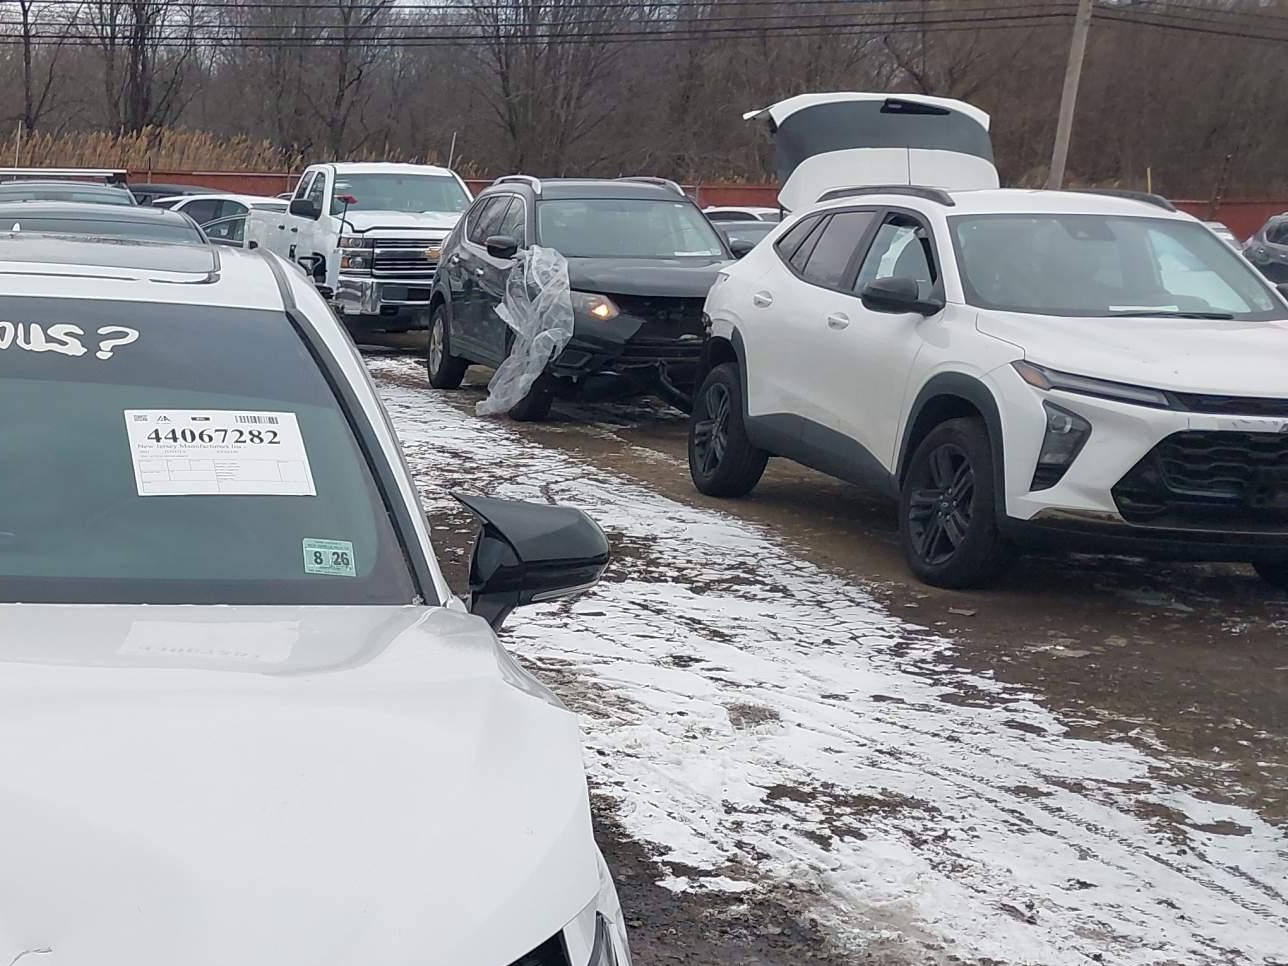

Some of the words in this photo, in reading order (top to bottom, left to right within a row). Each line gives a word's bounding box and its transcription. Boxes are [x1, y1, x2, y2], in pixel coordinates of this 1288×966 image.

[147, 428, 281, 445] 44067282
[314, 551, 323, 565] 8
[332, 551, 350, 566] 26
